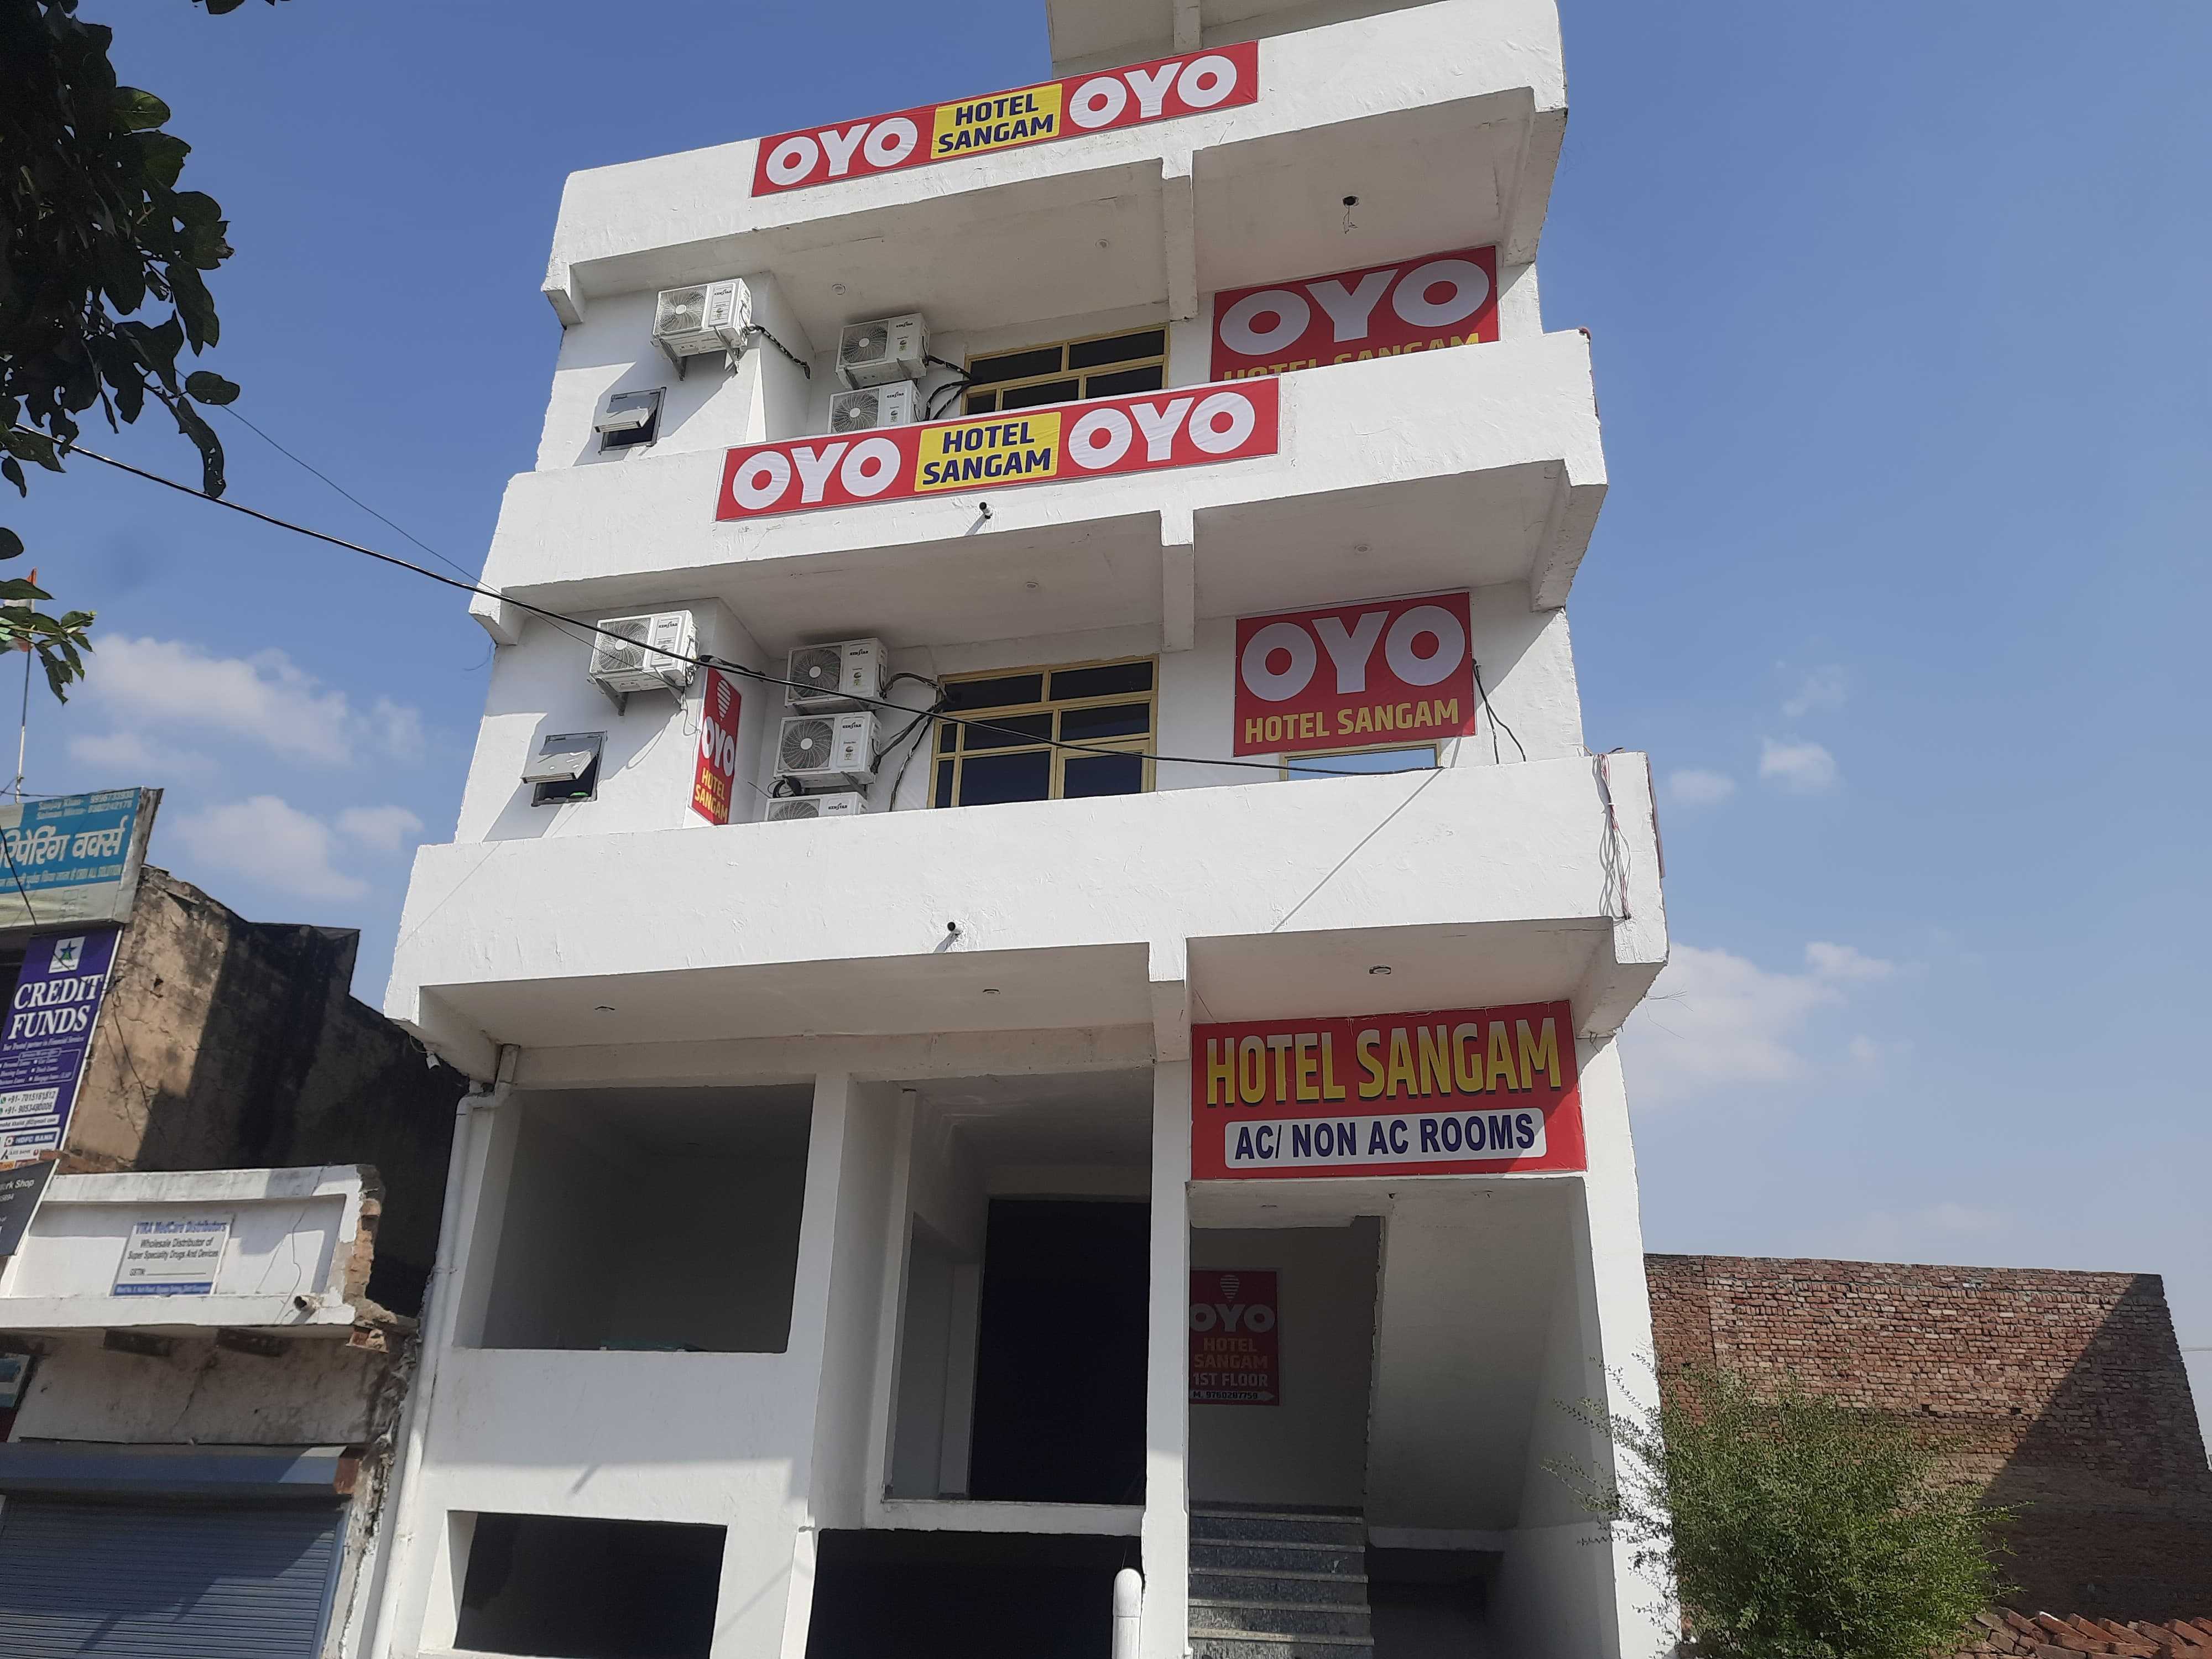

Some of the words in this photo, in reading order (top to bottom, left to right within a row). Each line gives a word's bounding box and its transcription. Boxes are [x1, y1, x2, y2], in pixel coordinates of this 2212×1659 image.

[956, 93, 1040, 126] HOTEL
[1069, 55, 1238, 128] OYO
[766, 117, 918, 185] OYO
[938, 113, 1053, 153] SANGAM
[1220, 259, 1490, 356] OYO
[942, 421, 1035, 453] HOTEL
[1068, 392, 1255, 469] OYO
[733, 437, 901, 510] OYO
[923, 448, 1051, 485] SANGAM
[1241, 605, 1465, 702] OYO
[1245, 712, 1330, 744] HOTEL
[1337, 698, 1459, 735] SANGAM
[702, 716, 735, 777] OYO
[701, 767, 726, 801] HOTEL
[694, 784, 729, 823] SANGAM
[14, 973, 105, 1010] CREDIT
[8, 1004, 91, 1040] FUNDS
[1207, 1032, 1346, 1105] HOTEL
[1358, 1017, 1562, 1098] SANGAM
[15, 1135, 33, 1145] HDFC
[35, 1134, 54, 1142] BANK
[1235, 1124, 1282, 1160] AC/
[1293, 1122, 1357, 1157] NON
[1368, 1120, 1408, 1155] AC
[1420, 1113, 1535, 1154] ROOMS
[15, 1179, 35, 1188] Shop
[1190, 1303, 1275, 1333] OYO
[1194, 1354, 1269, 1369] SANGAM
[1203, 1337, 1257, 1352] HOTEL
[1193, 1373, 1217, 1385] 1ST
[1222, 1374, 1268, 1386] FLOOR
